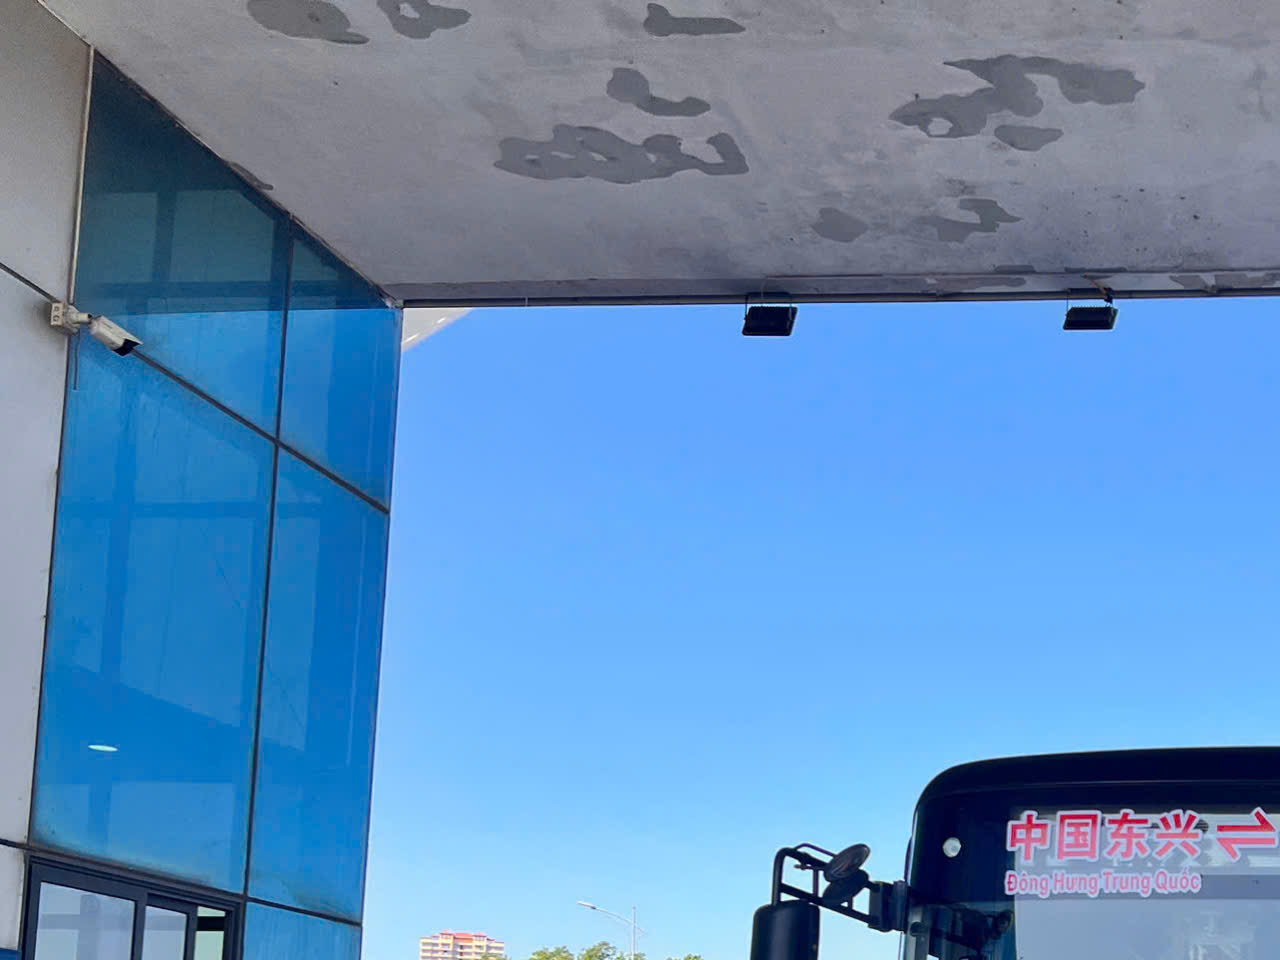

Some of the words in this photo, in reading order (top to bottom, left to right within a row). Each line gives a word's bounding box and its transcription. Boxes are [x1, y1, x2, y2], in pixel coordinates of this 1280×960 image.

[1006, 810, 1202, 862] 中国东兴
[1053, 873, 1097, 896] Hưng
[1103, 872, 1150, 895] Trung
[1155, 865, 1200, 892] Quốc
